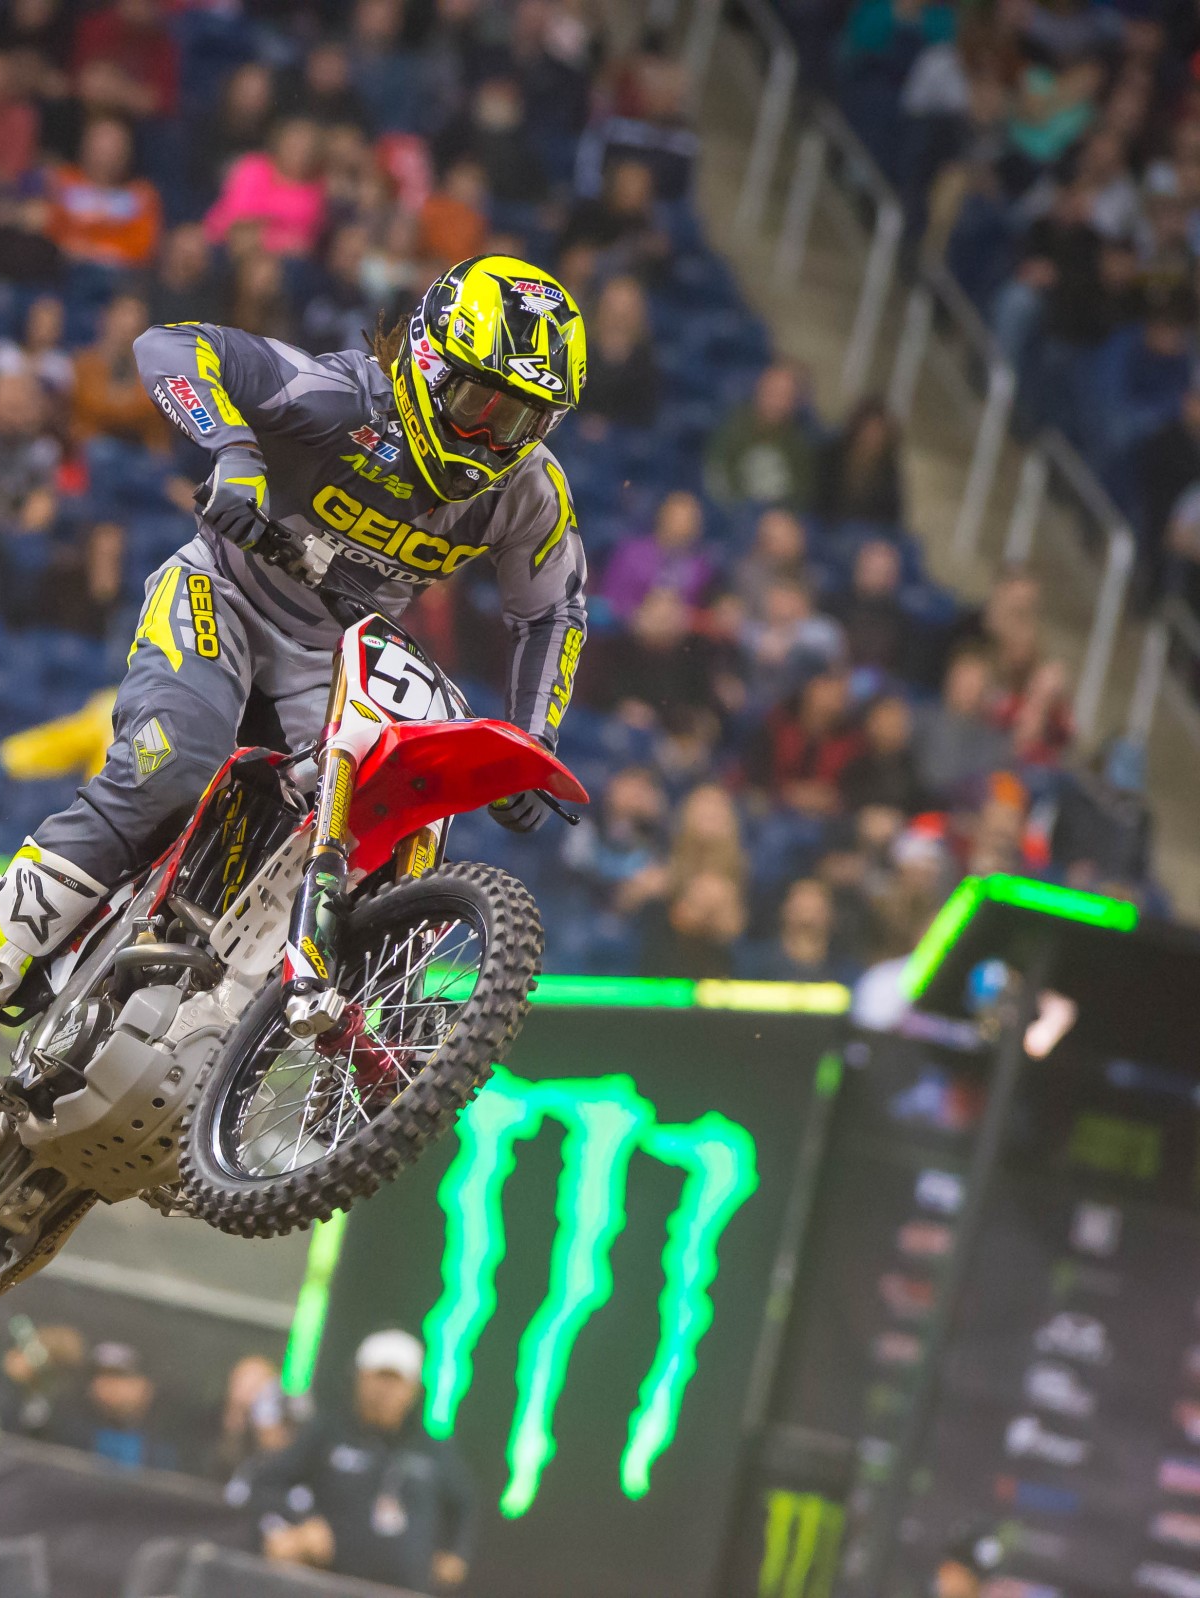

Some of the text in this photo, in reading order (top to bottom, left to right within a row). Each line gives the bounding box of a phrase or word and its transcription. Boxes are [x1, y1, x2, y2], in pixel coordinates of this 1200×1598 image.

[511, 281, 564, 301] AMSOIL
[519, 304, 557, 326] HONDA
[166, 375, 216, 434] AMSOIL
[396, 374, 430, 458] GEICO
[188, 574, 219, 658] GEICO
[300, 936, 328, 980] GEICO
